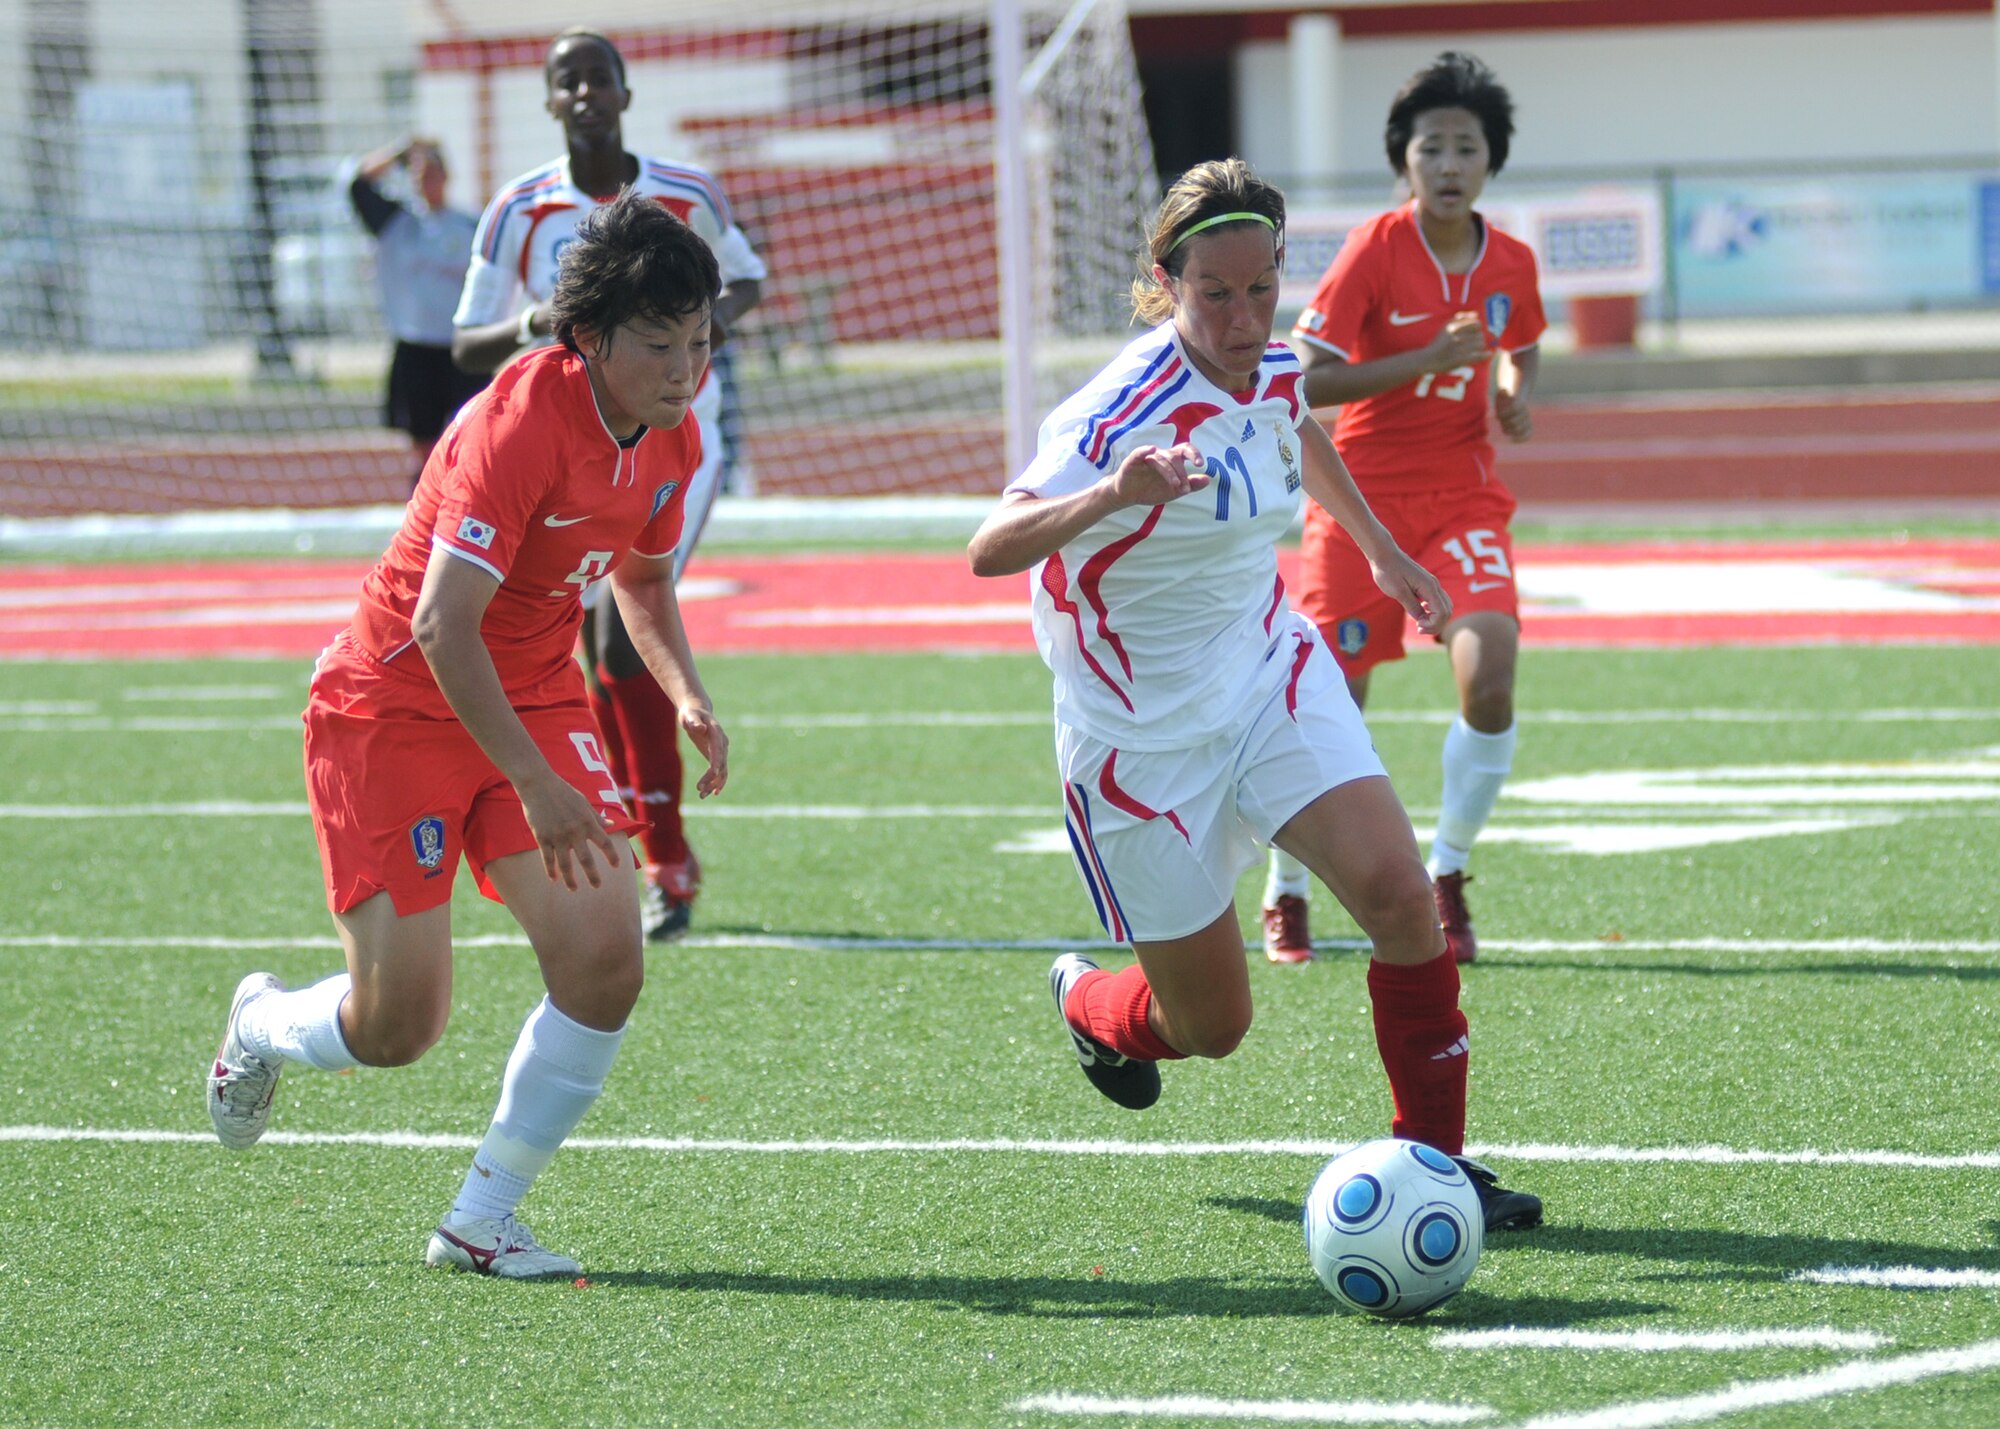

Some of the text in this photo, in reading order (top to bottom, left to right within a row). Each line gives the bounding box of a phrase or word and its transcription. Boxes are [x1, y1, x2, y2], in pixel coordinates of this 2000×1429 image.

[1205, 446, 1257, 521] 11
[1443, 529, 1512, 578] 15
[568, 732, 624, 804] 9
